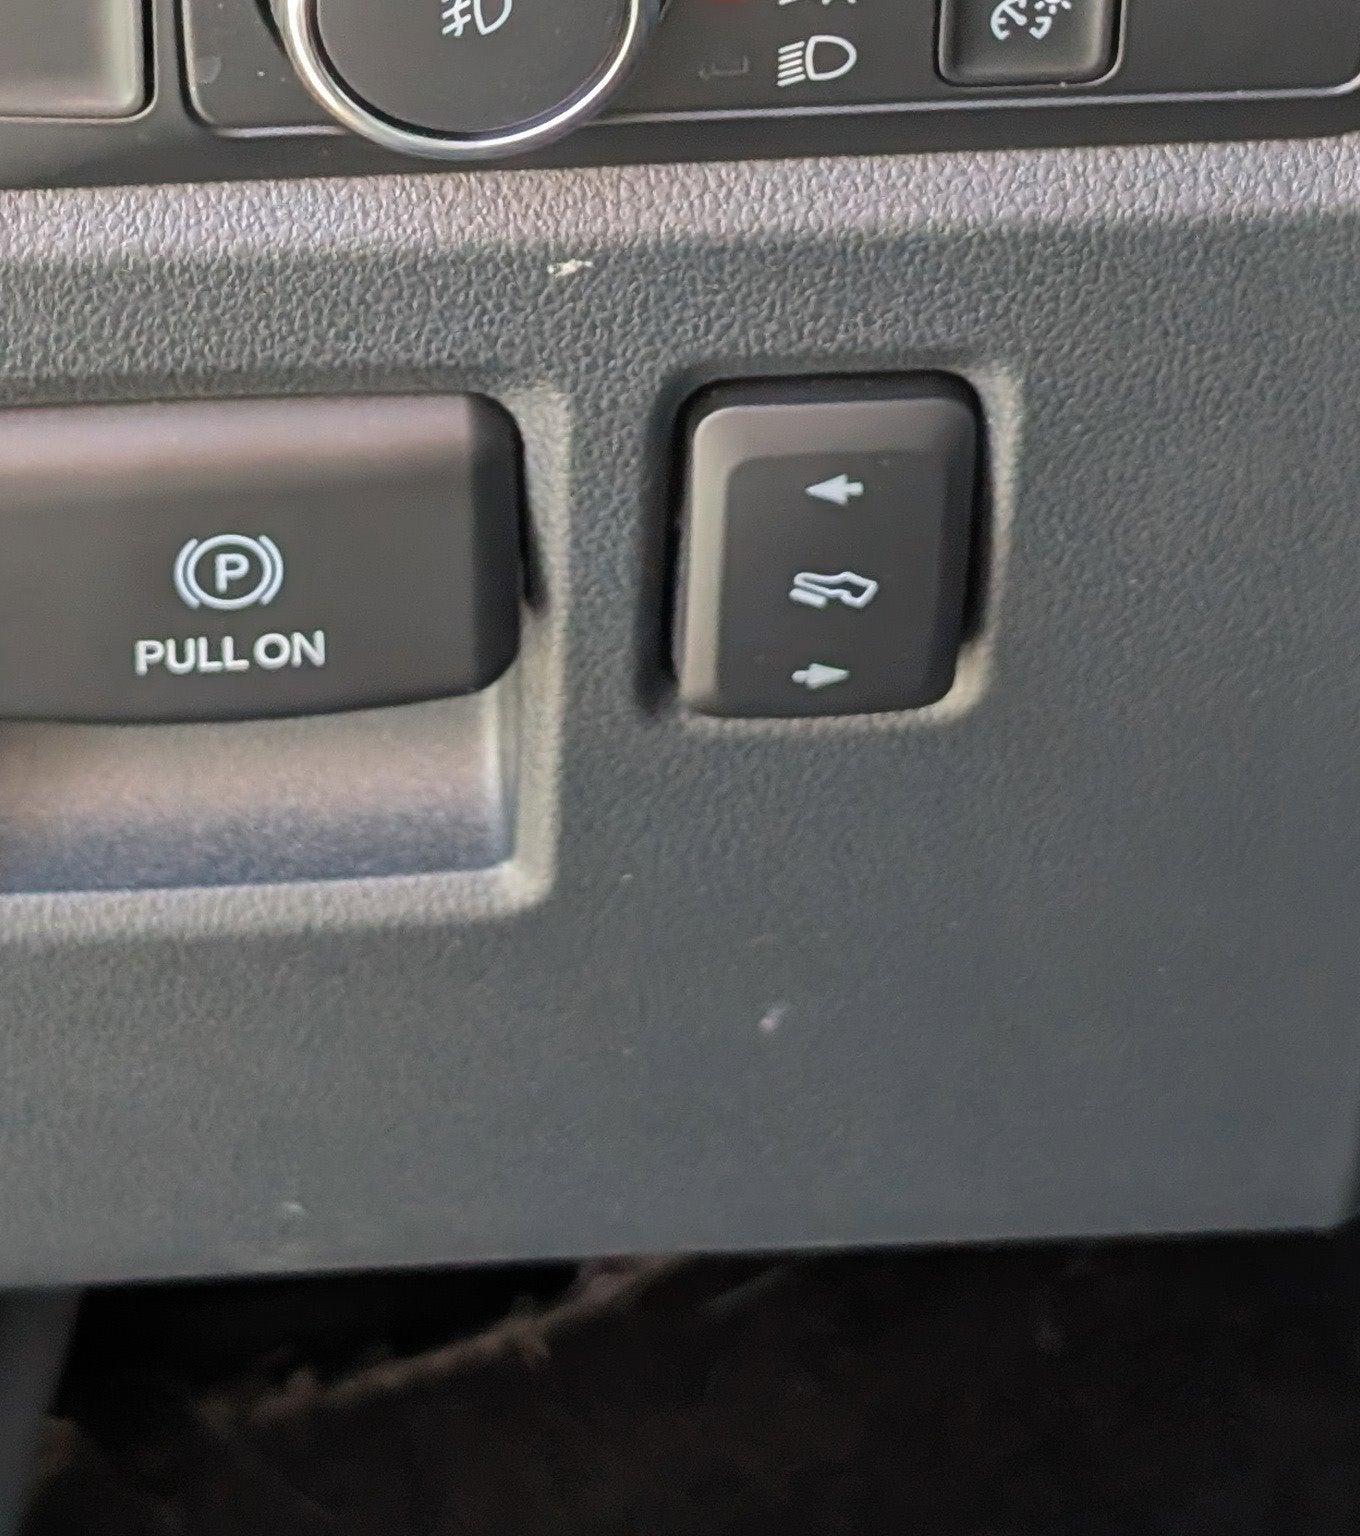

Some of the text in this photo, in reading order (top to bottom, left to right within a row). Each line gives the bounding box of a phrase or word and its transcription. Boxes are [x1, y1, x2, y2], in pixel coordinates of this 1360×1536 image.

[214, 552, 251, 594] P
[134, 629, 327, 676] PULL ON
